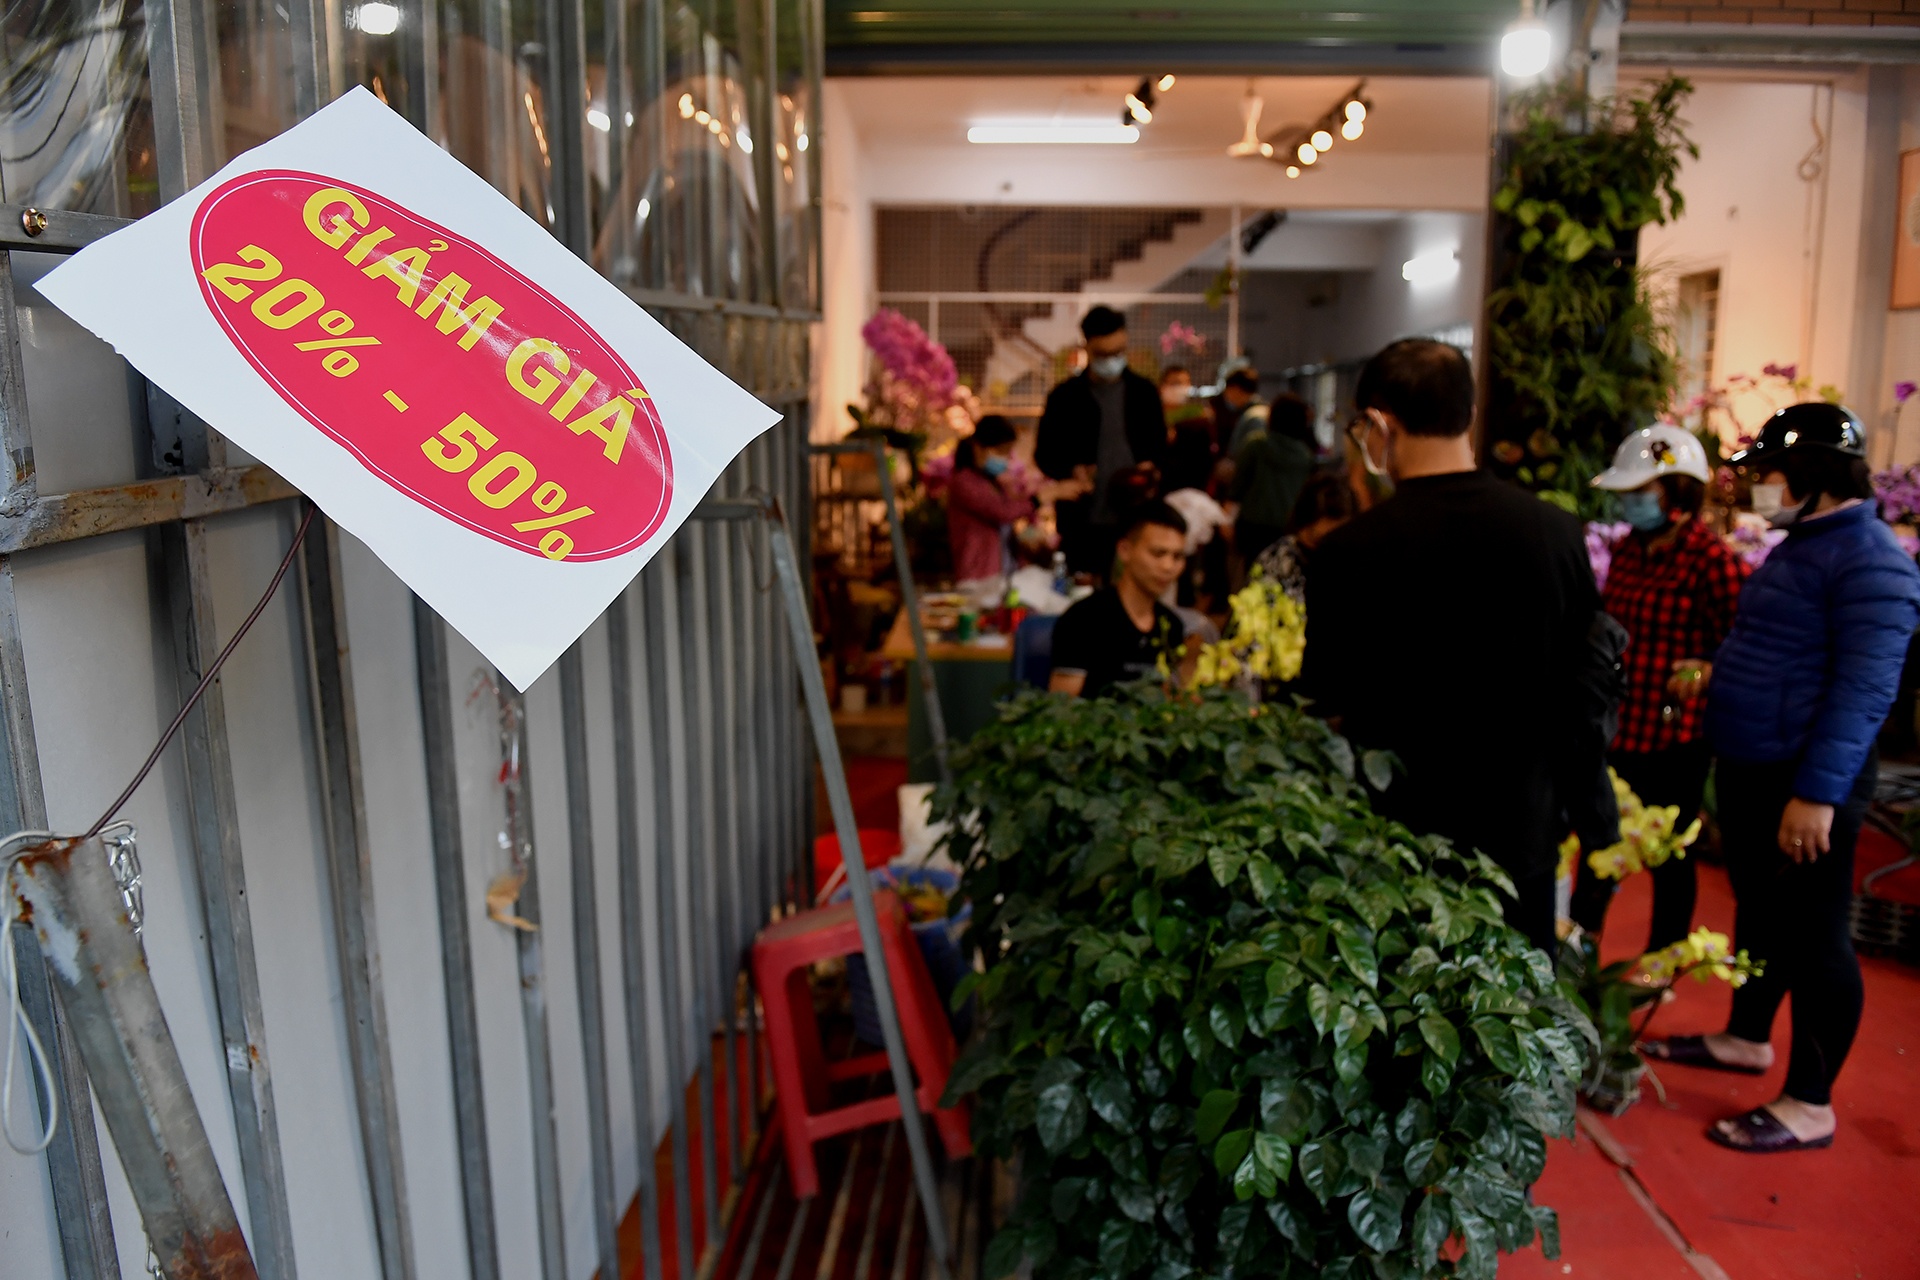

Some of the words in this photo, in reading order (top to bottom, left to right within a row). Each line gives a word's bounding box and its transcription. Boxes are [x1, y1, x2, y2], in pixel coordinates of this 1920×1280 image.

[201, 244, 383, 378] 20%
[382, 389, 410, 413] -
[420, 411, 596, 561] 50%
[302, 187, 505, 352] GIẢM
[505, 337, 653, 465] GIÁ
